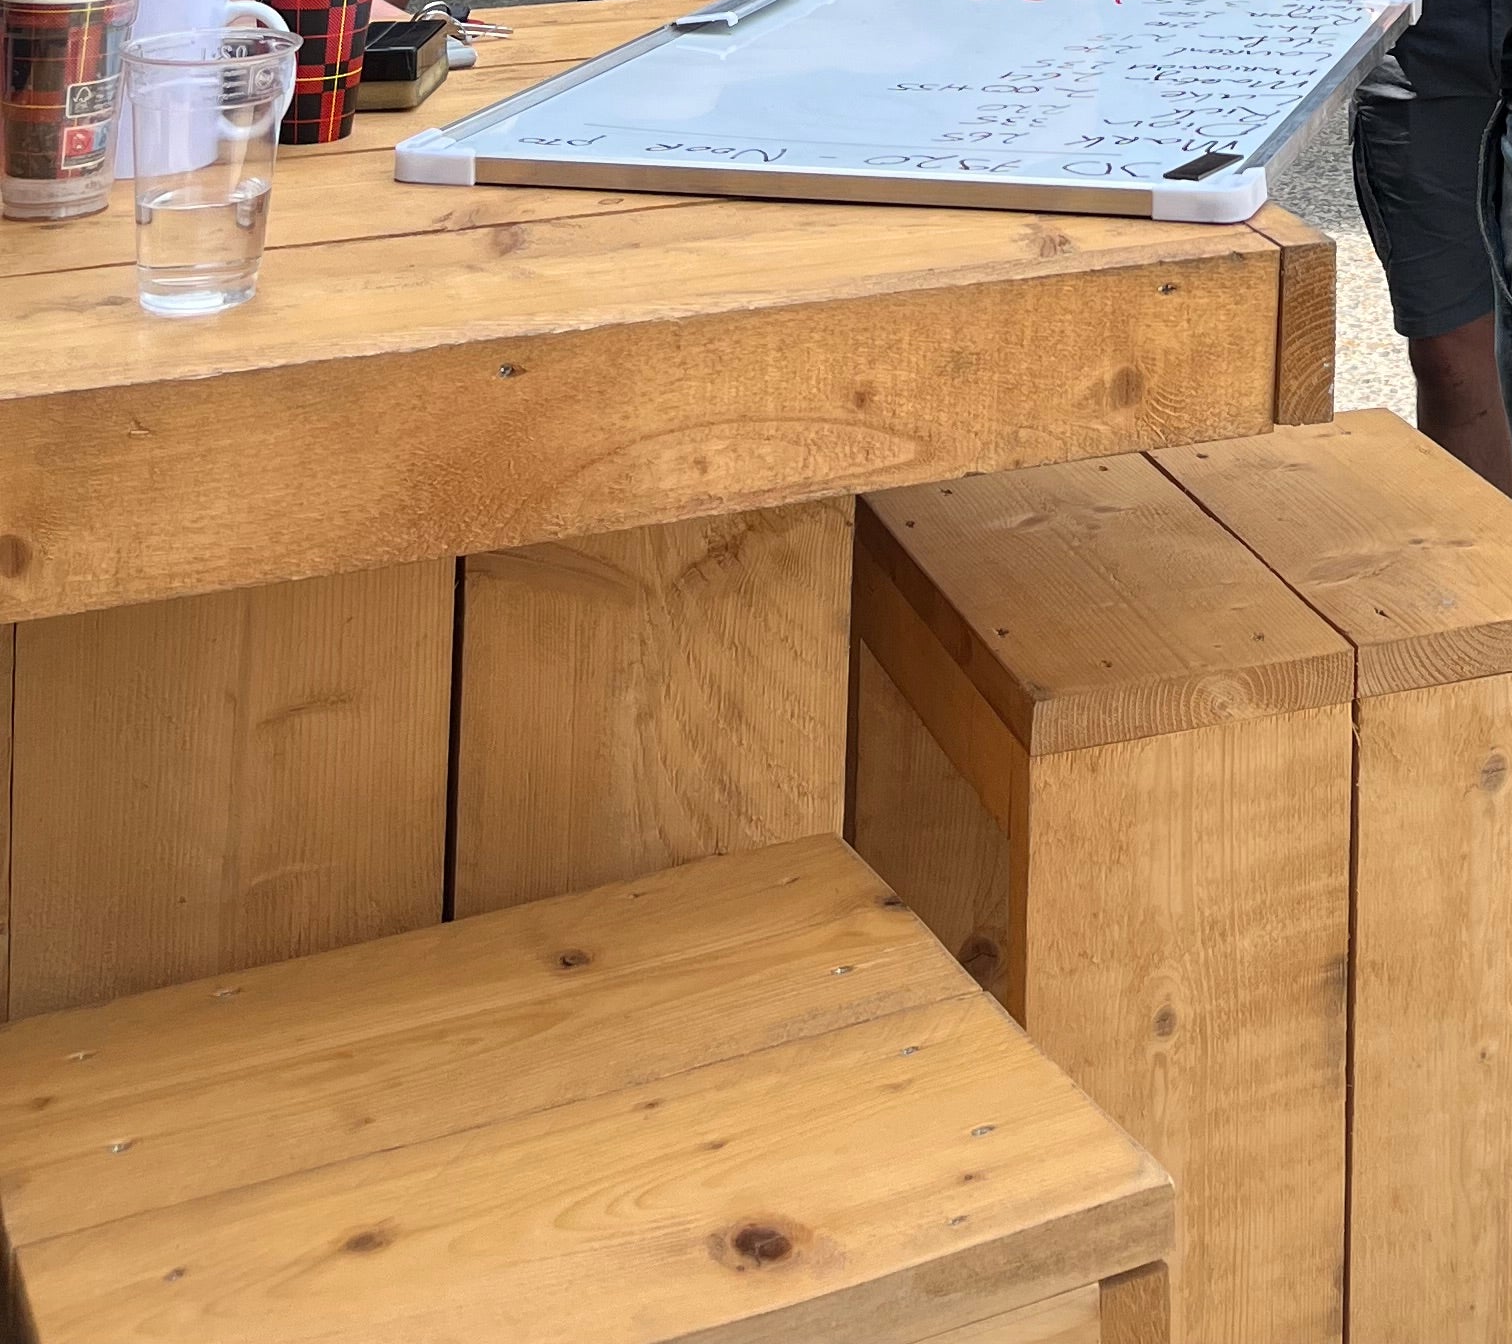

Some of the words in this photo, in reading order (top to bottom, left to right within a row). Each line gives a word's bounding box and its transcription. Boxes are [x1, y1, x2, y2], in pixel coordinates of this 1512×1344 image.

[977, 104, 1071, 114] 220
[958, 116, 1048, 128] 335
[1103, 119, 1268, 138] Dion
[931, 132, 1030, 144] 265
